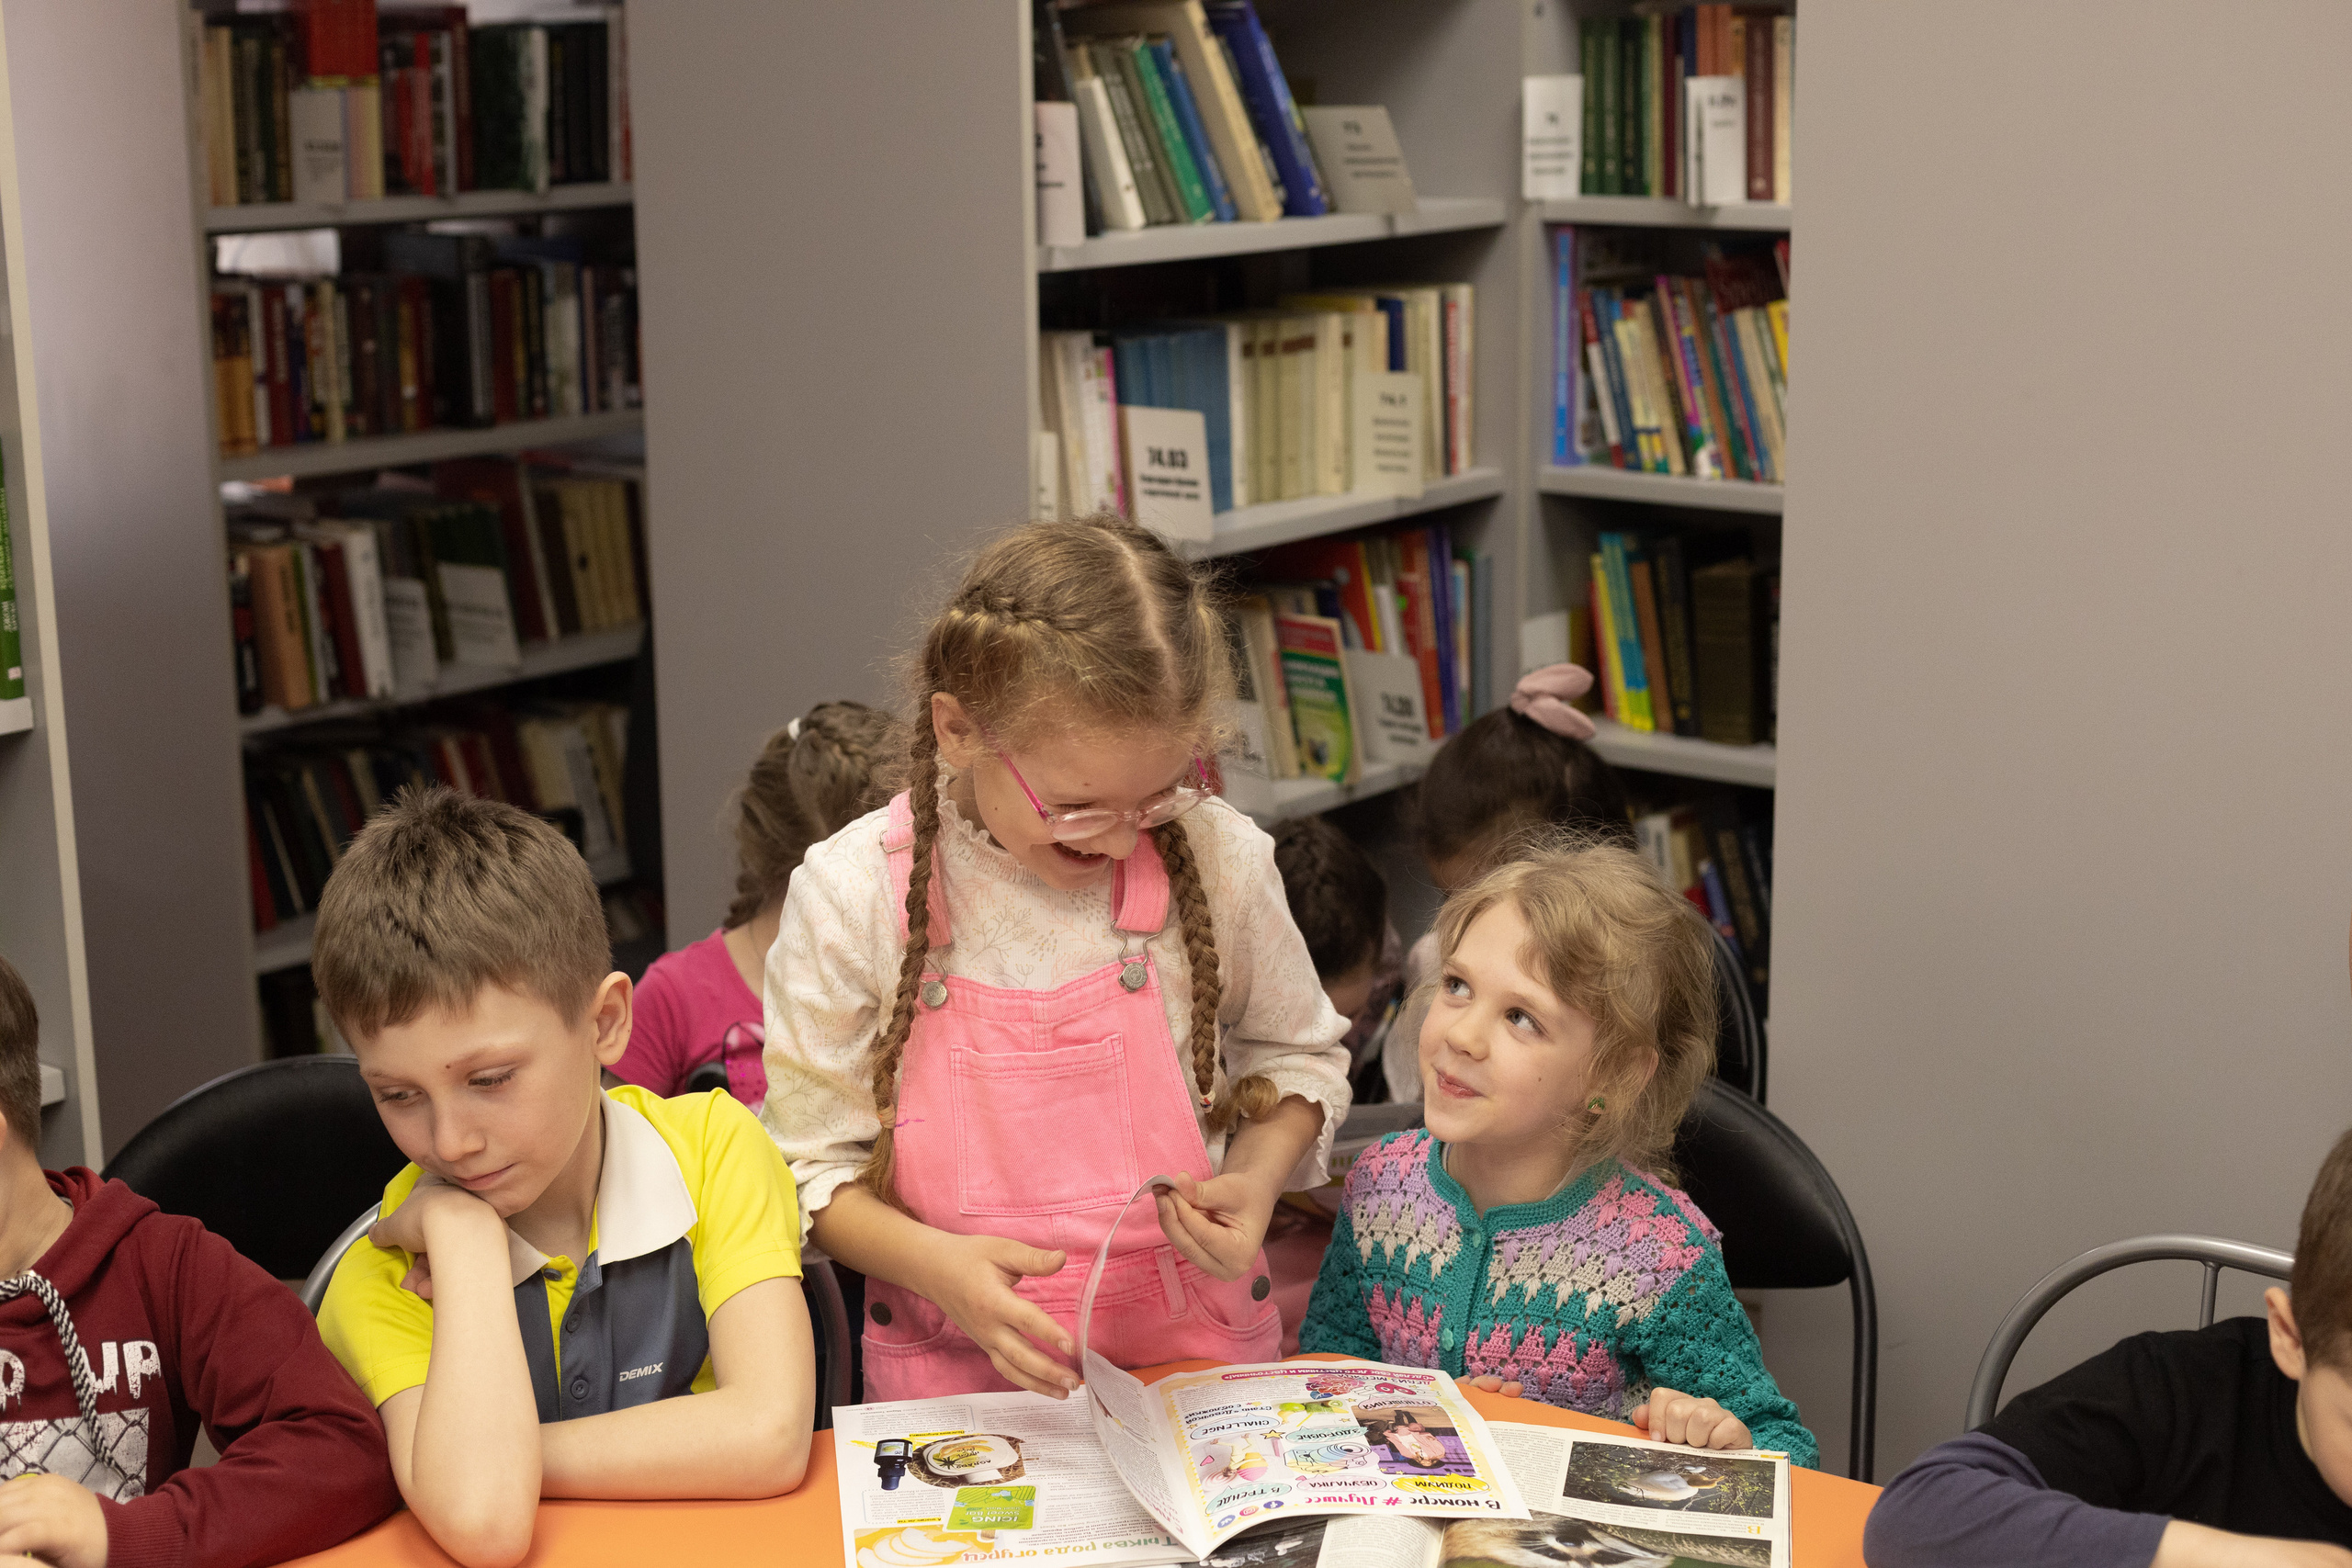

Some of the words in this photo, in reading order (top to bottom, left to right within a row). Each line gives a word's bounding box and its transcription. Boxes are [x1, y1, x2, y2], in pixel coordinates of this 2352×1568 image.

[618, 1361, 663, 1382] DEMIX
[1391, 1377, 1431, 1385] ДЕВИЗ
[1362, 1400, 1431, 1410] ОТНОШЕНИЯ
[1201, 1419, 1270, 1436] CHALLENGE
[1296, 1427, 1362, 1440] ЗДОРОВЬЕ
[1271, 1486, 1281, 1495] В
[1308, 1480, 1378, 1489] ОБУЧАЛКА
[1414, 1480, 1472, 1490] ПОДИУМ
[1216, 1487, 1267, 1507] ТРЕНДЕ
[1304, 1493, 1378, 1506] Лучшее
[1409, 1495, 1479, 1507] номере
[1485, 1499, 1501, 1510] В
[1044, 1540, 1097, 1556] рода
[1102, 1536, 1179, 1550] Тыква
[961, 1548, 1037, 1563] огурец
